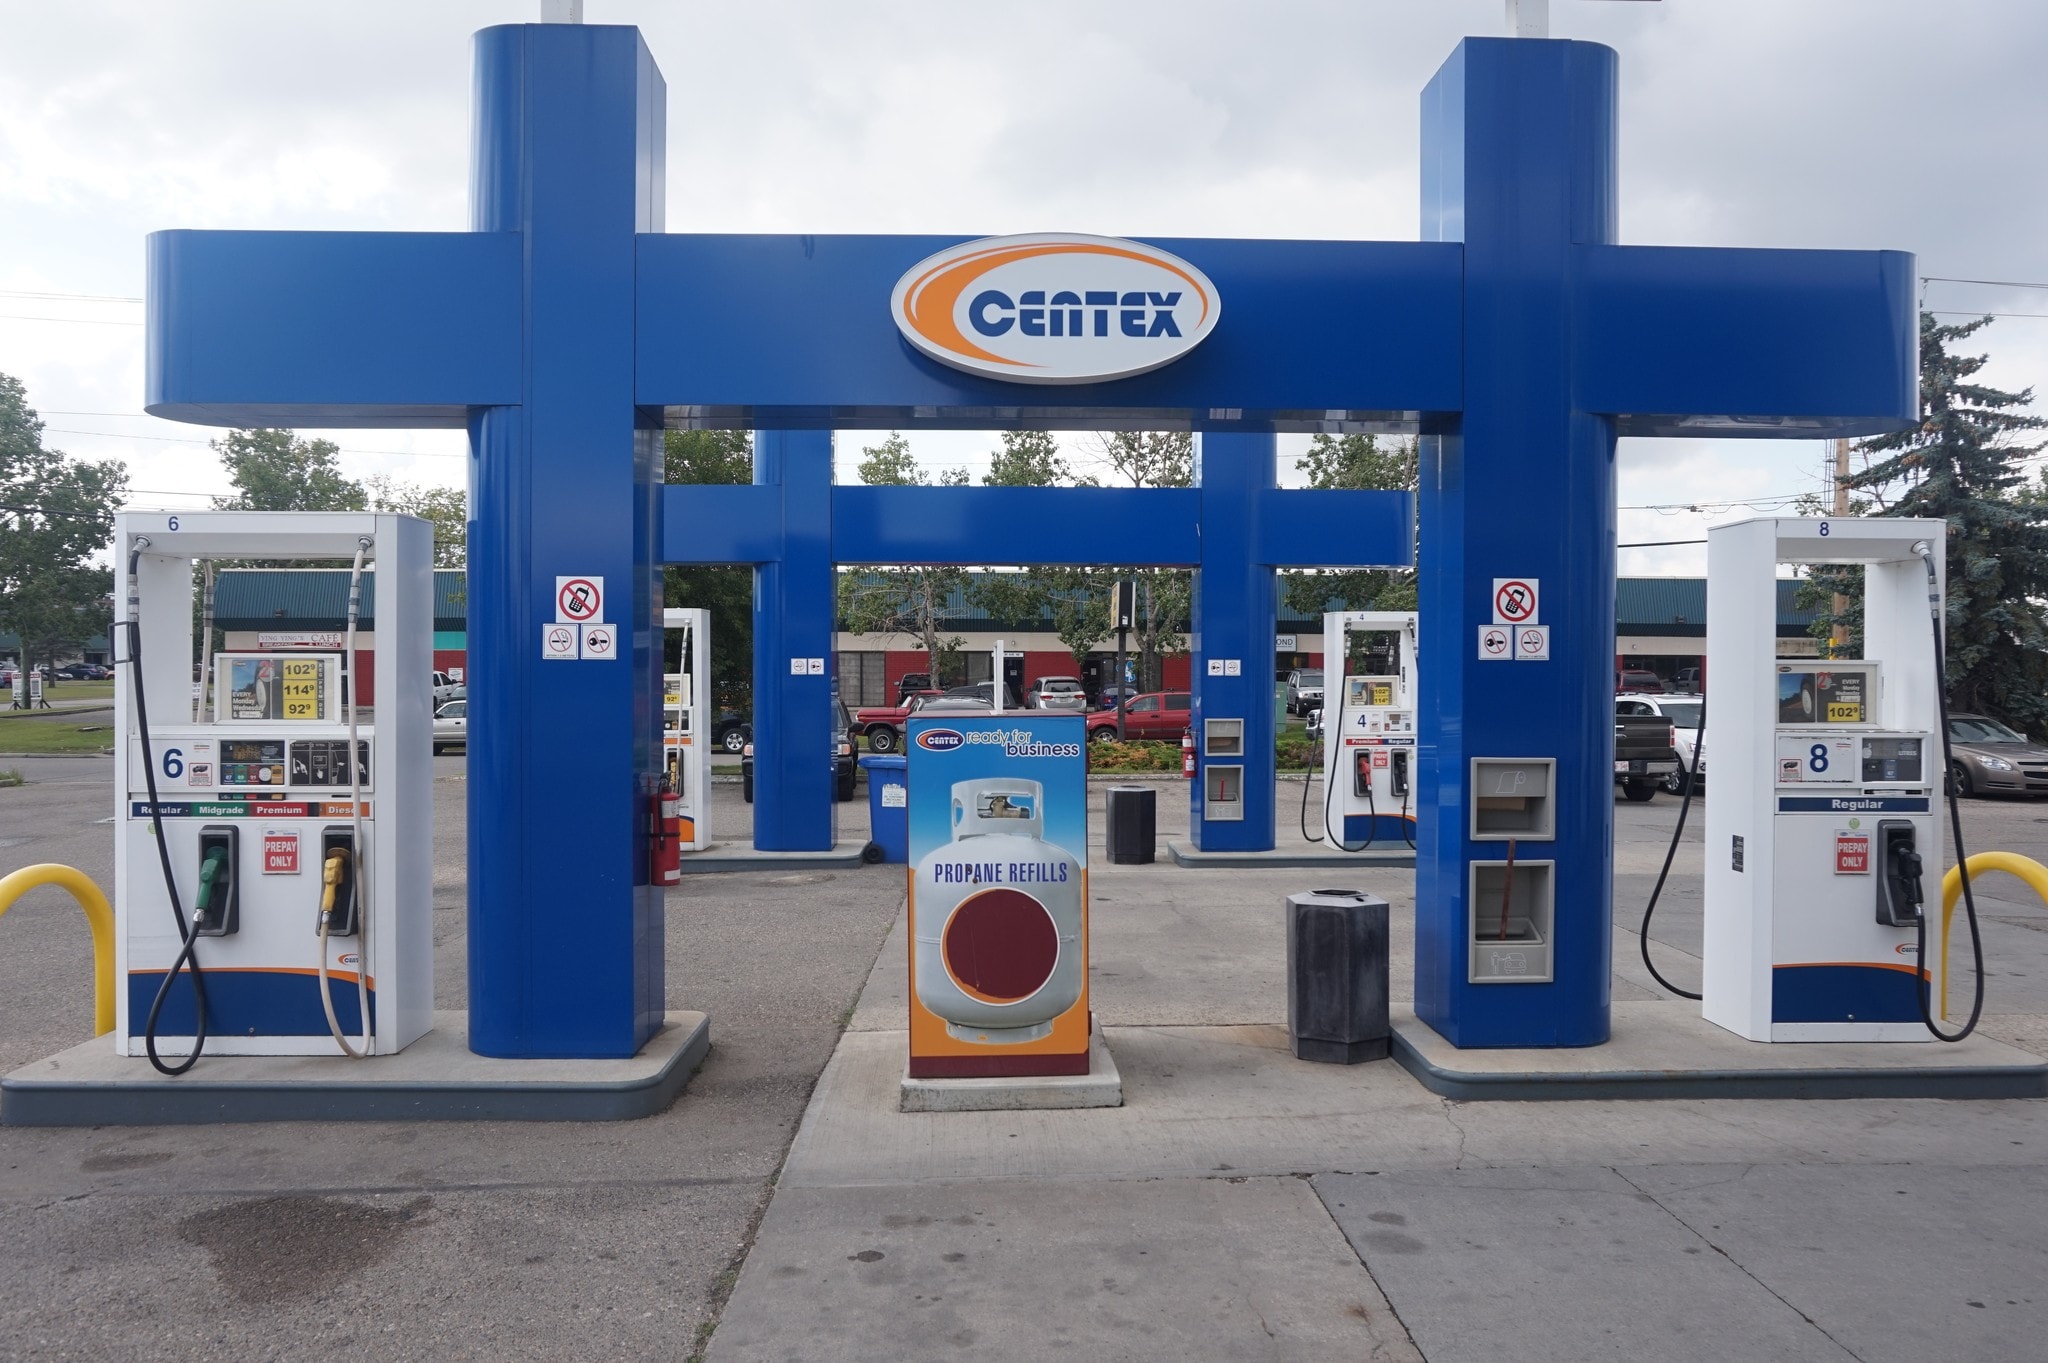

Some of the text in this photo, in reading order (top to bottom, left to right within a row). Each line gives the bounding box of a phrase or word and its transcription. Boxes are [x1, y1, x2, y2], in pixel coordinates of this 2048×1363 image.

[969, 290, 1182, 337] CENTEX
[169, 516, 178, 531] 6
[1820, 522, 1829, 536] 8
[311, 633, 339, 642] CAFÉ
[1357, 714, 1367, 727] 4
[927, 729, 1032, 747] CENTEX ready for
[1006, 741, 1079, 757] business
[163, 748, 184, 779] 6
[1810, 743, 1829, 773] 8
[141, 806, 181, 814] Reular
[199, 806, 244, 815] Midgrade
[256, 806, 302, 814] Premium
[1832, 799, 1884, 811] Regular
[265, 841, 297, 852] PREPAY
[1838, 842, 1868, 853] PREPAY
[270, 855, 293, 867] ONLY
[1842, 856, 1863, 867] ONLY
[934, 862, 1068, 883] PROPANE REFILLS
